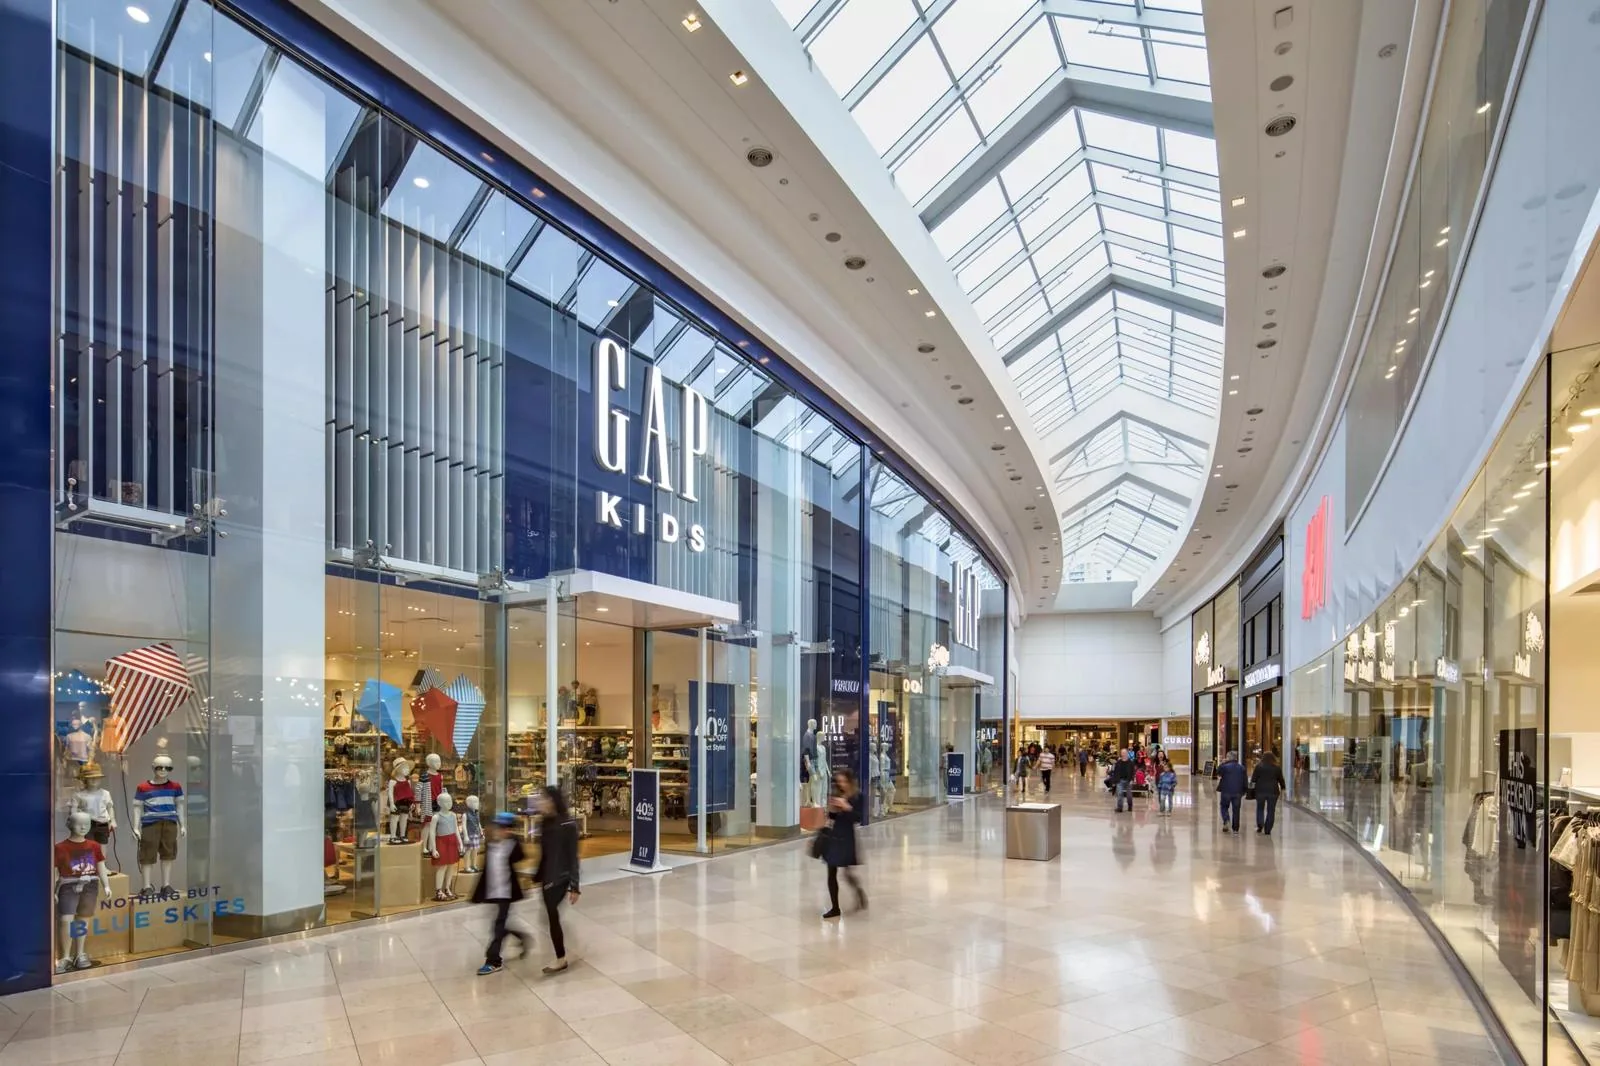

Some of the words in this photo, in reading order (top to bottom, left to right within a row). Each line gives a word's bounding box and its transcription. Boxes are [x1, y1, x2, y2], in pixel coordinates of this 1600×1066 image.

[596, 338, 707, 503] GAP
[596, 491, 706, 552] KIDS
[955, 561, 981, 650] GAP
[822, 715, 845, 734] GAP
[981, 727, 997, 741] GAP
[635, 802, 655, 816] 40%
[101, 890, 181, 910] NOTHING
[187, 886, 221, 899] BUT
[70, 912, 150, 938] BLUE
[164, 897, 246, 924] SKIES
